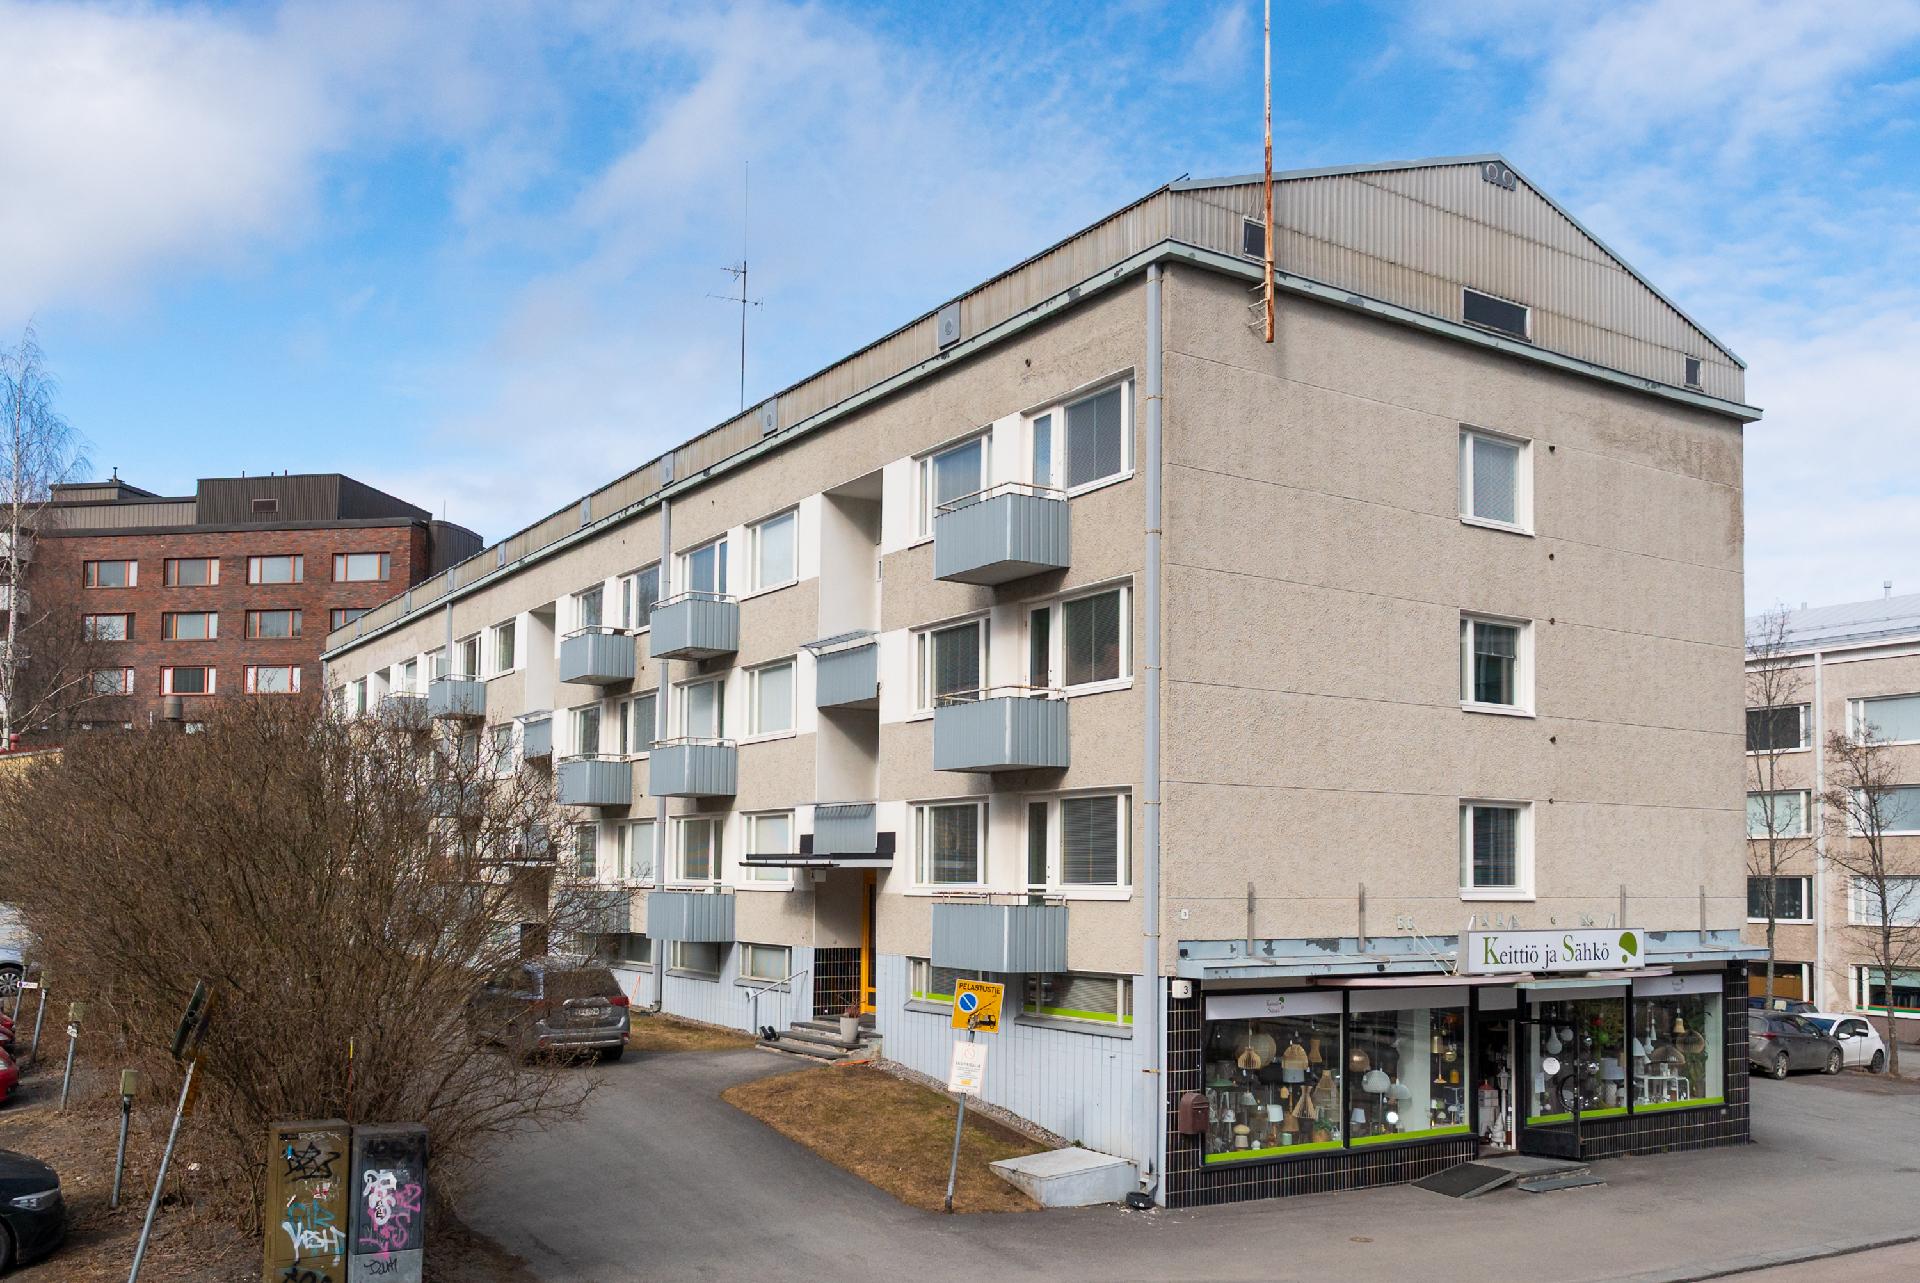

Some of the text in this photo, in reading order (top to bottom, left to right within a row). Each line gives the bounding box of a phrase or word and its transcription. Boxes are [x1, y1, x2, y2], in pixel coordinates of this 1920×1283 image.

[1482, 934, 1610, 970] Keittiö ja Sähkö
[958, 982, 1001, 995] PELASTUSTIE
[1183, 985, 1189, 995] 3
